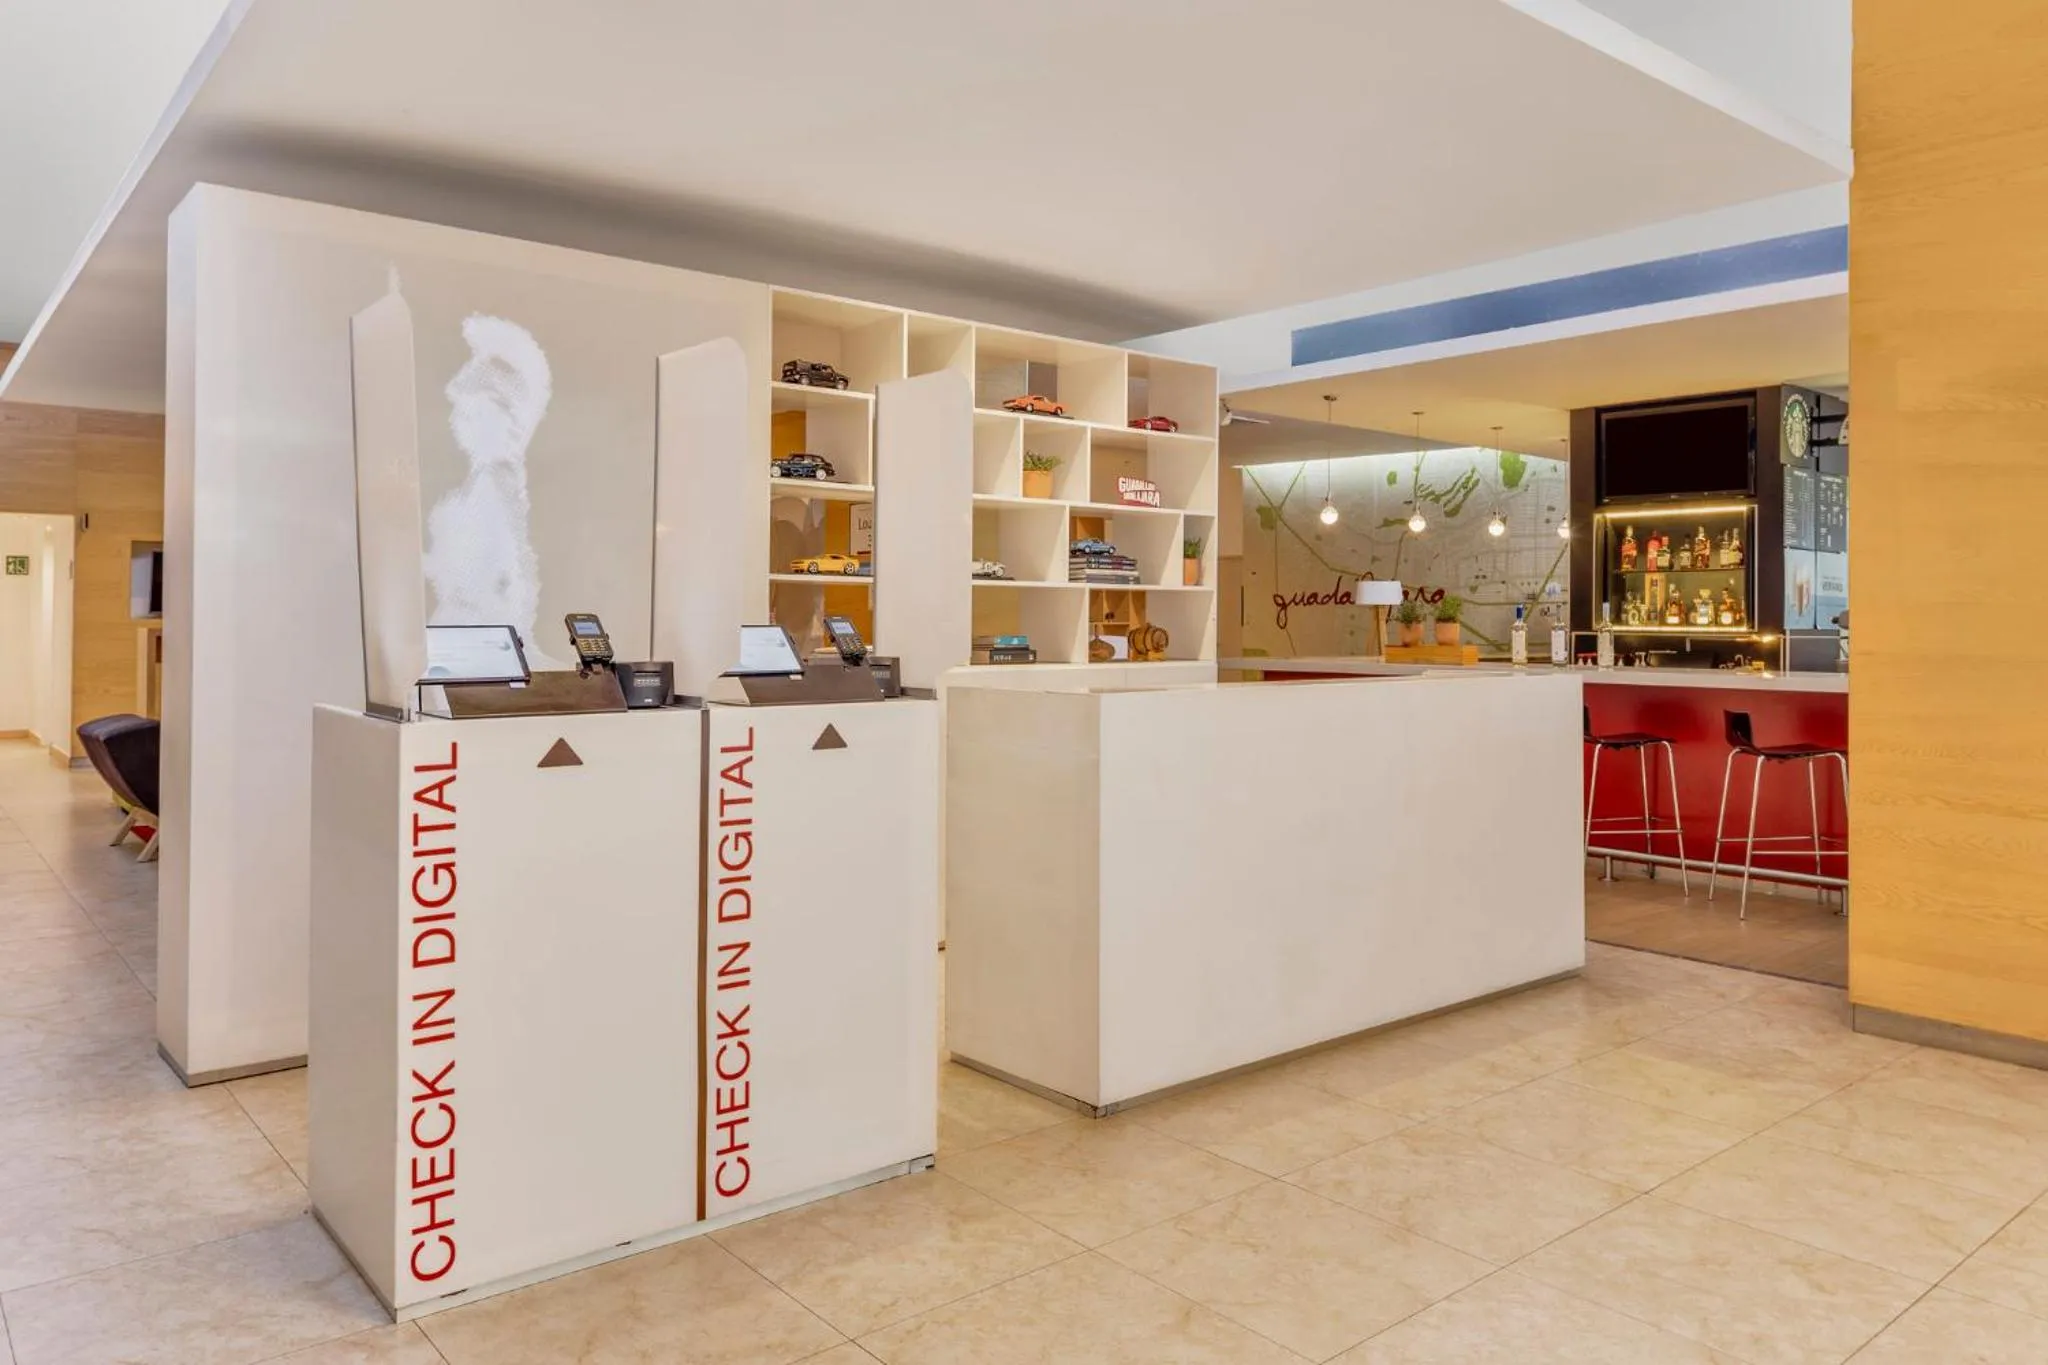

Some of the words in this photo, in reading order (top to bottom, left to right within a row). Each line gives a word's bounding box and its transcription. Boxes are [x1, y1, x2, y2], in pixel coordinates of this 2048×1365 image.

[411, 741, 459, 969] DIGITAL
[717, 726, 754, 924] DIGITAL
[411, 988, 456, 1047] IN
[717, 941, 751, 991] IN
[410, 1061, 457, 1283] CHECK
[715, 1004, 751, 1198] CHECK
